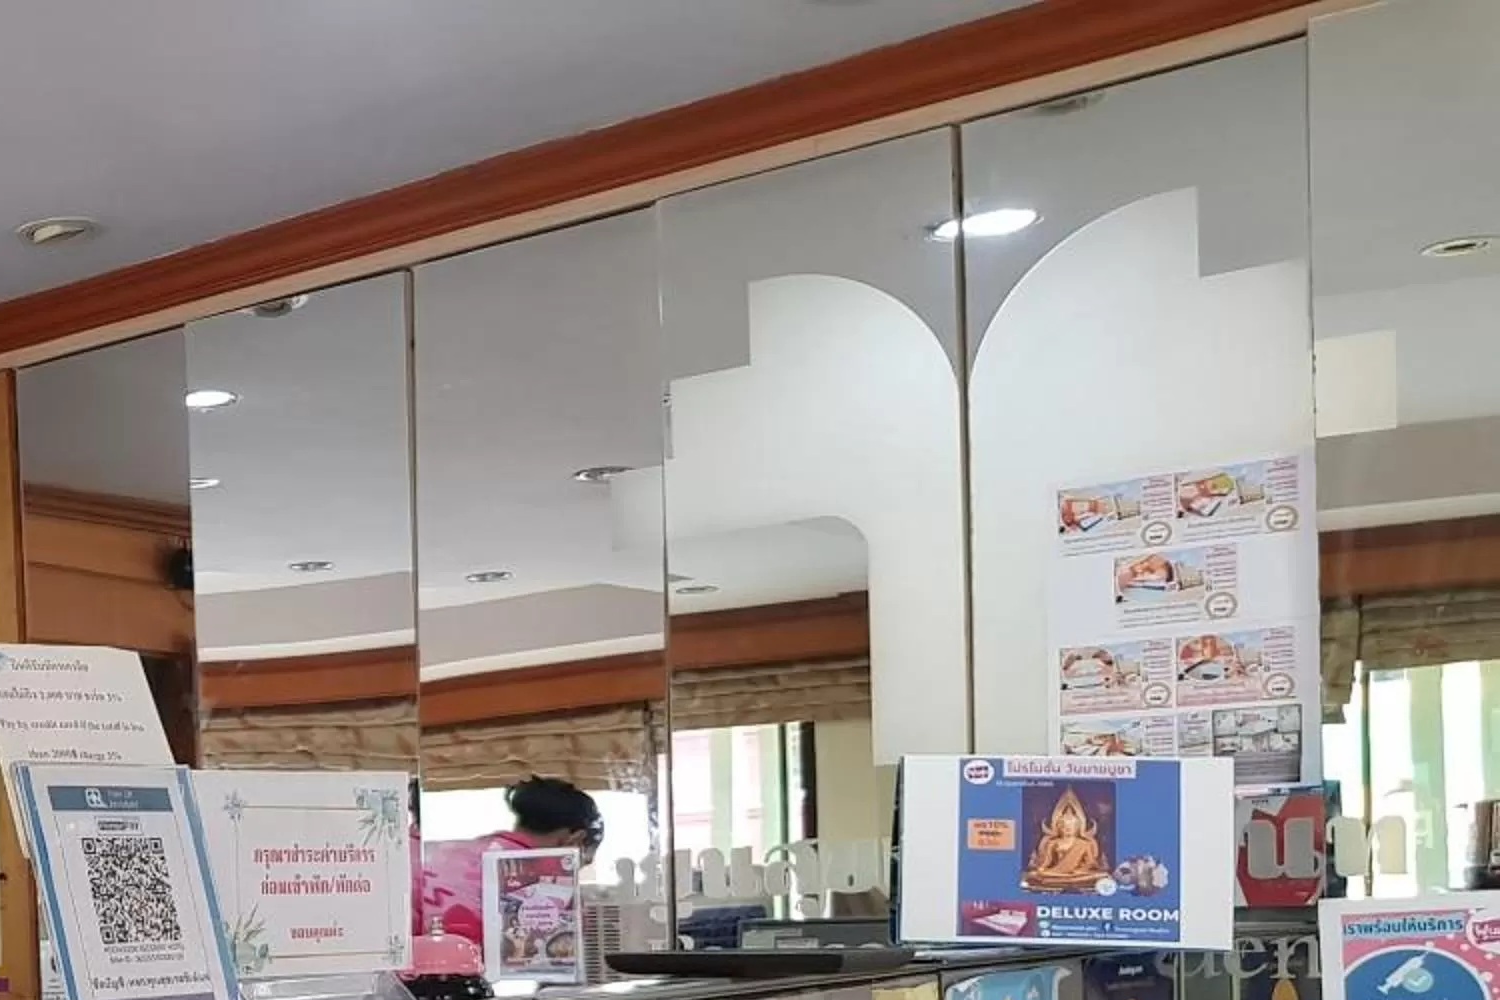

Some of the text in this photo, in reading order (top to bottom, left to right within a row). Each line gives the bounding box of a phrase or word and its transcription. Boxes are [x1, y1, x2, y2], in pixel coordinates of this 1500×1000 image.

[1036, 905, 1179, 922] DELUXE ROOM
[1342, 916, 1465, 936] เราพร้อมให้บริการ
